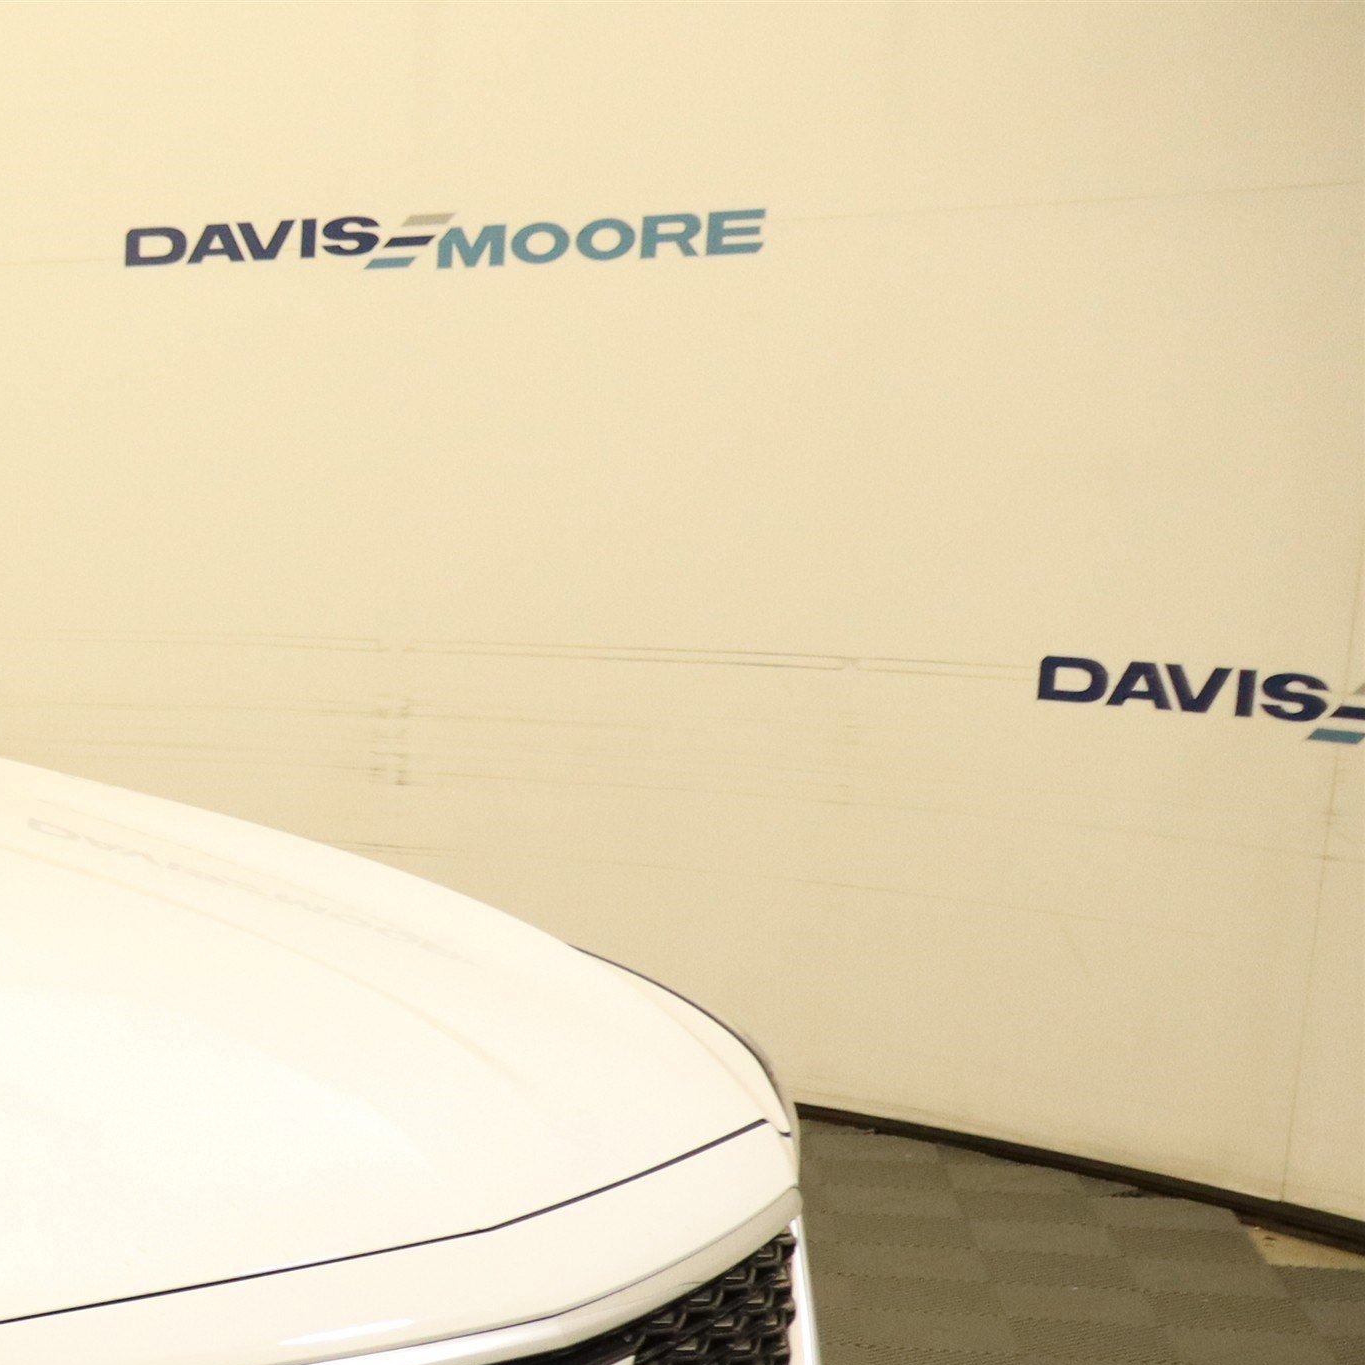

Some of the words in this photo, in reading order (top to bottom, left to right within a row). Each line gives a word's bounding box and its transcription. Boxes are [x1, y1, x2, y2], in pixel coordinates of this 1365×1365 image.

[123, 215, 381, 268] DAVIS
[435, 208, 767, 270] MOORE
[1035, 655, 1331, 723] DAVIS
